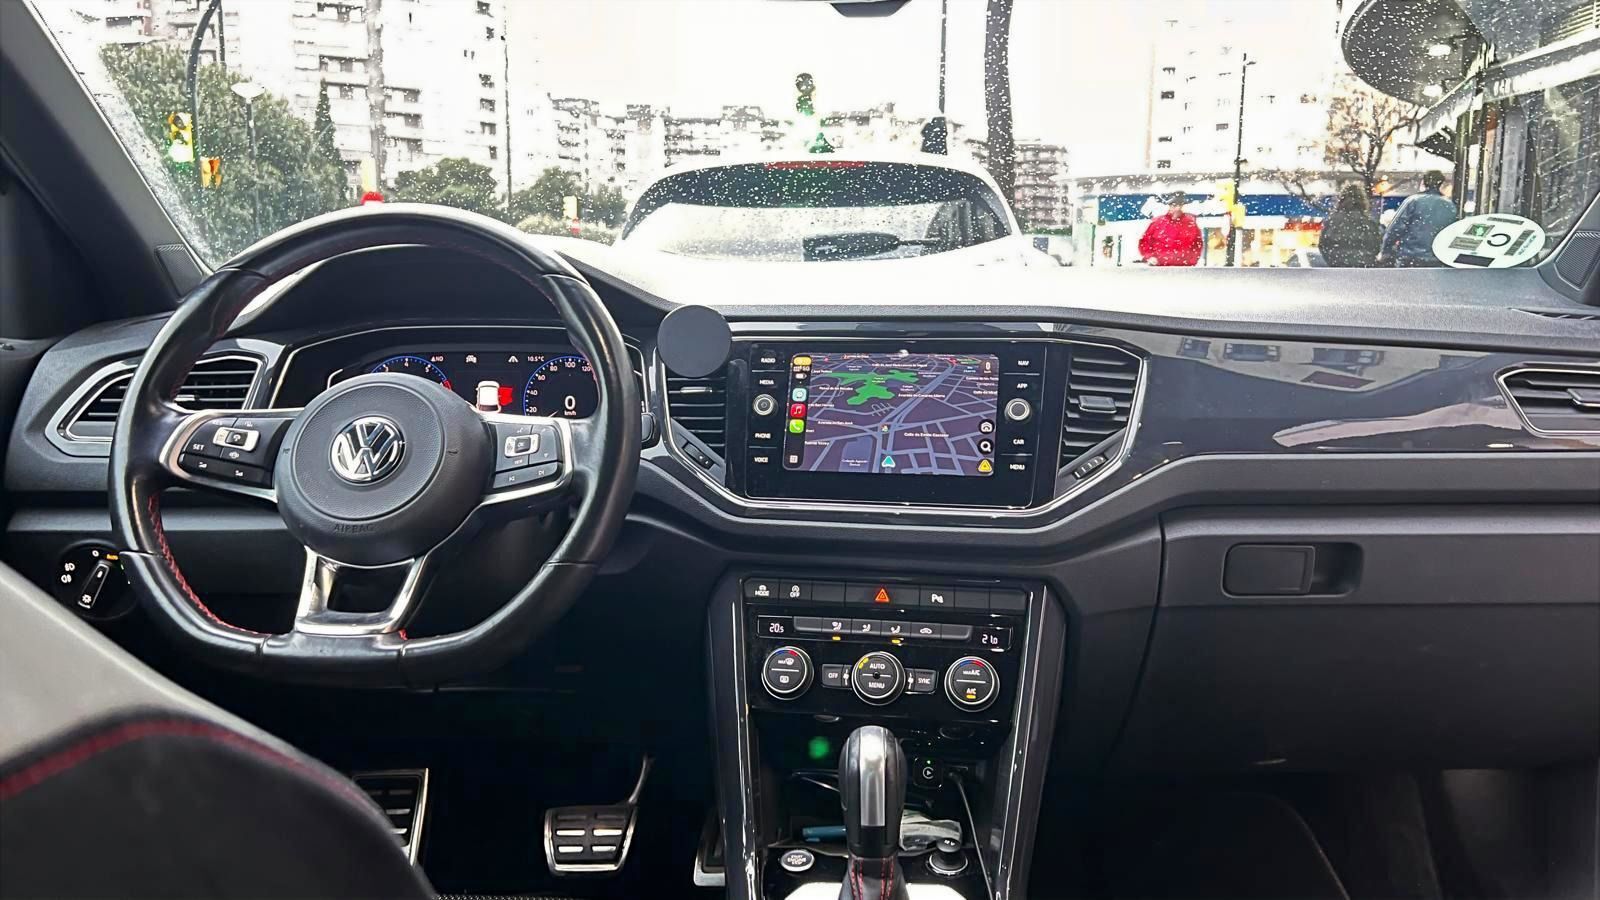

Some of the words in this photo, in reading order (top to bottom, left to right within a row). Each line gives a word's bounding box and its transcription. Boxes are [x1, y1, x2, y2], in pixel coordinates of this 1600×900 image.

[564, 395, 576, 410] 0
[333, 523, 375, 533] AIRBAG
[868, 681, 886, 689] MENU
[917, 677, 931, 685] SYNC
